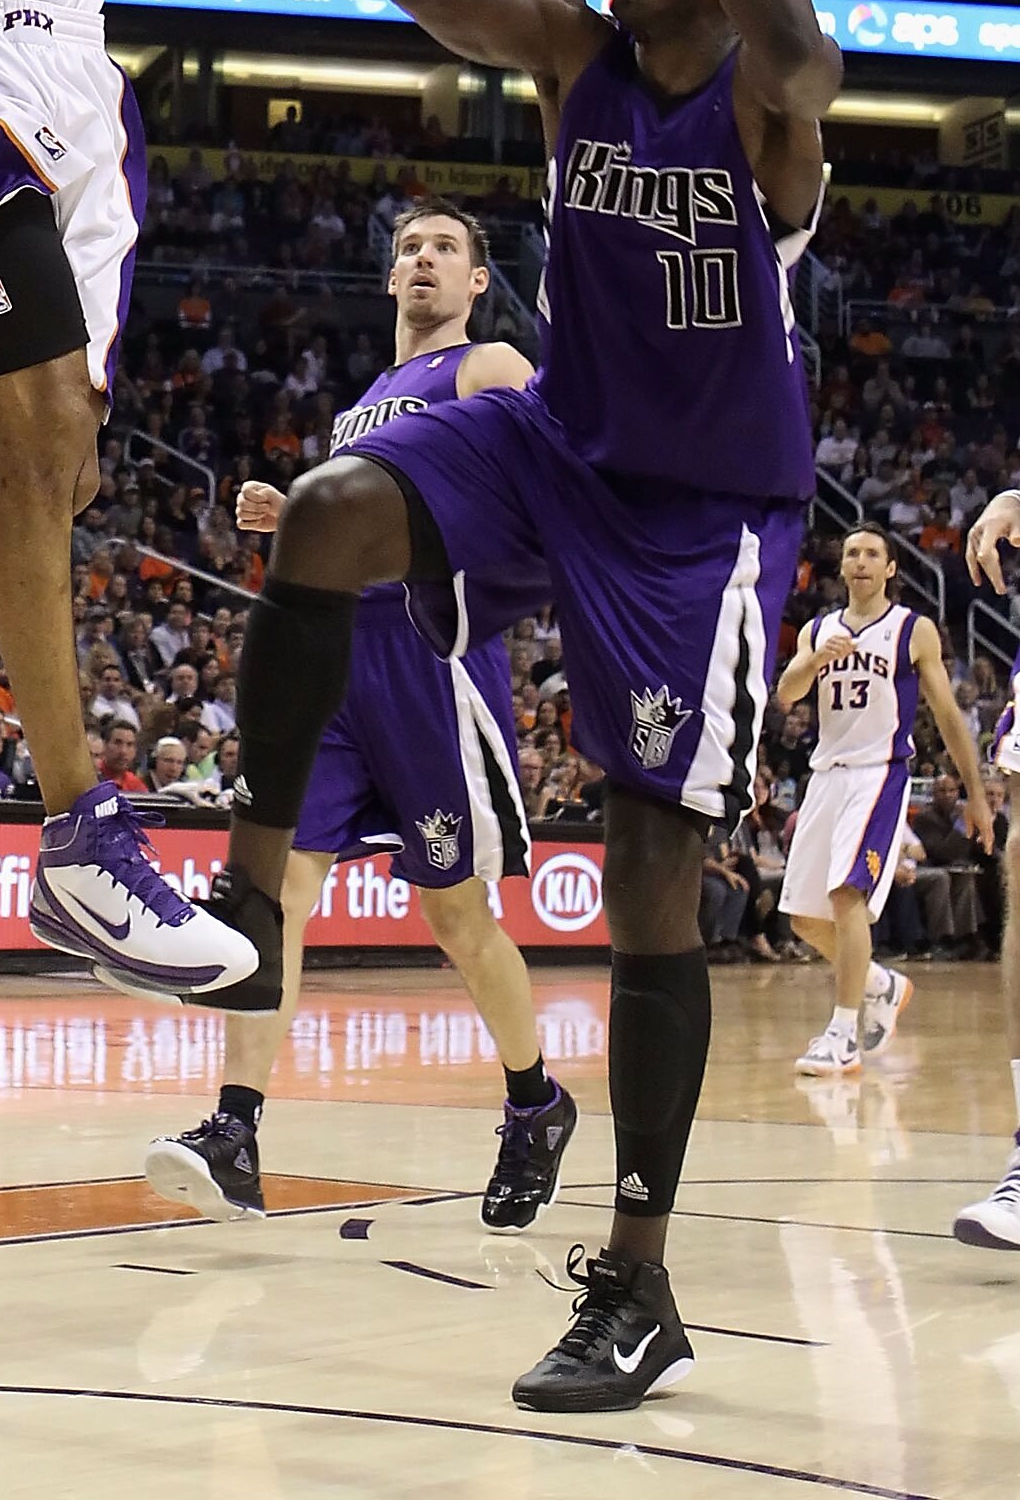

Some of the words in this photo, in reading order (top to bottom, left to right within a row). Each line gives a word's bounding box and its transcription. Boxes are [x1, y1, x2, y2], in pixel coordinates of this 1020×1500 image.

[3, 9, 55, 37] PHX
[891, 11, 960, 51] aps
[564, 137, 739, 246] Kings
[656, 248, 743, 330] 10
[831, 679, 871, 711] 13
[346, 860, 410, 919] the
[545, 871, 593, 913] KIA
